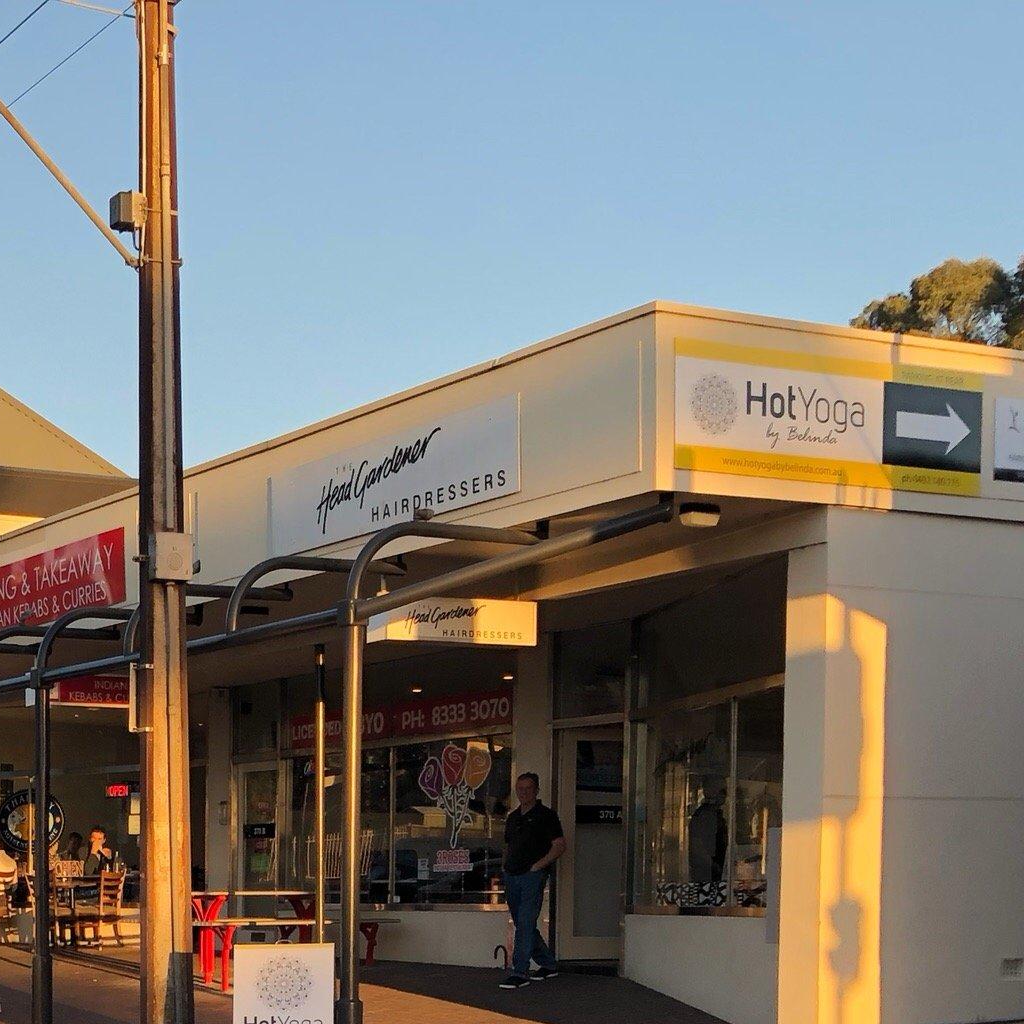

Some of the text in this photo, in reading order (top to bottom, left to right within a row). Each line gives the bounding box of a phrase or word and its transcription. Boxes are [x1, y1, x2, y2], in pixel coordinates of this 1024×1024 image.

[746, 381, 865, 433] HotYoga
[766, 423, 838, 449] by Belinda
[316, 427, 441, 534] Head Gardener
[371, 470, 506, 522] HAIRDRESSERS
[21, 571, 32, 596] &
[35, 542, 114, 592] TAKEAWAY
[52, 594, 60, 614] &
[62, 580, 108, 610] CURRIES
[404, 604, 487, 635] Head Gardener
[442, 629, 523, 640] HAIRDRESSERS
[69, 691, 104, 702] KEBABS
[292, 696, 510, 741] LICEED YO PH: 8333 3070
[108, 785, 129, 797] OPEN
